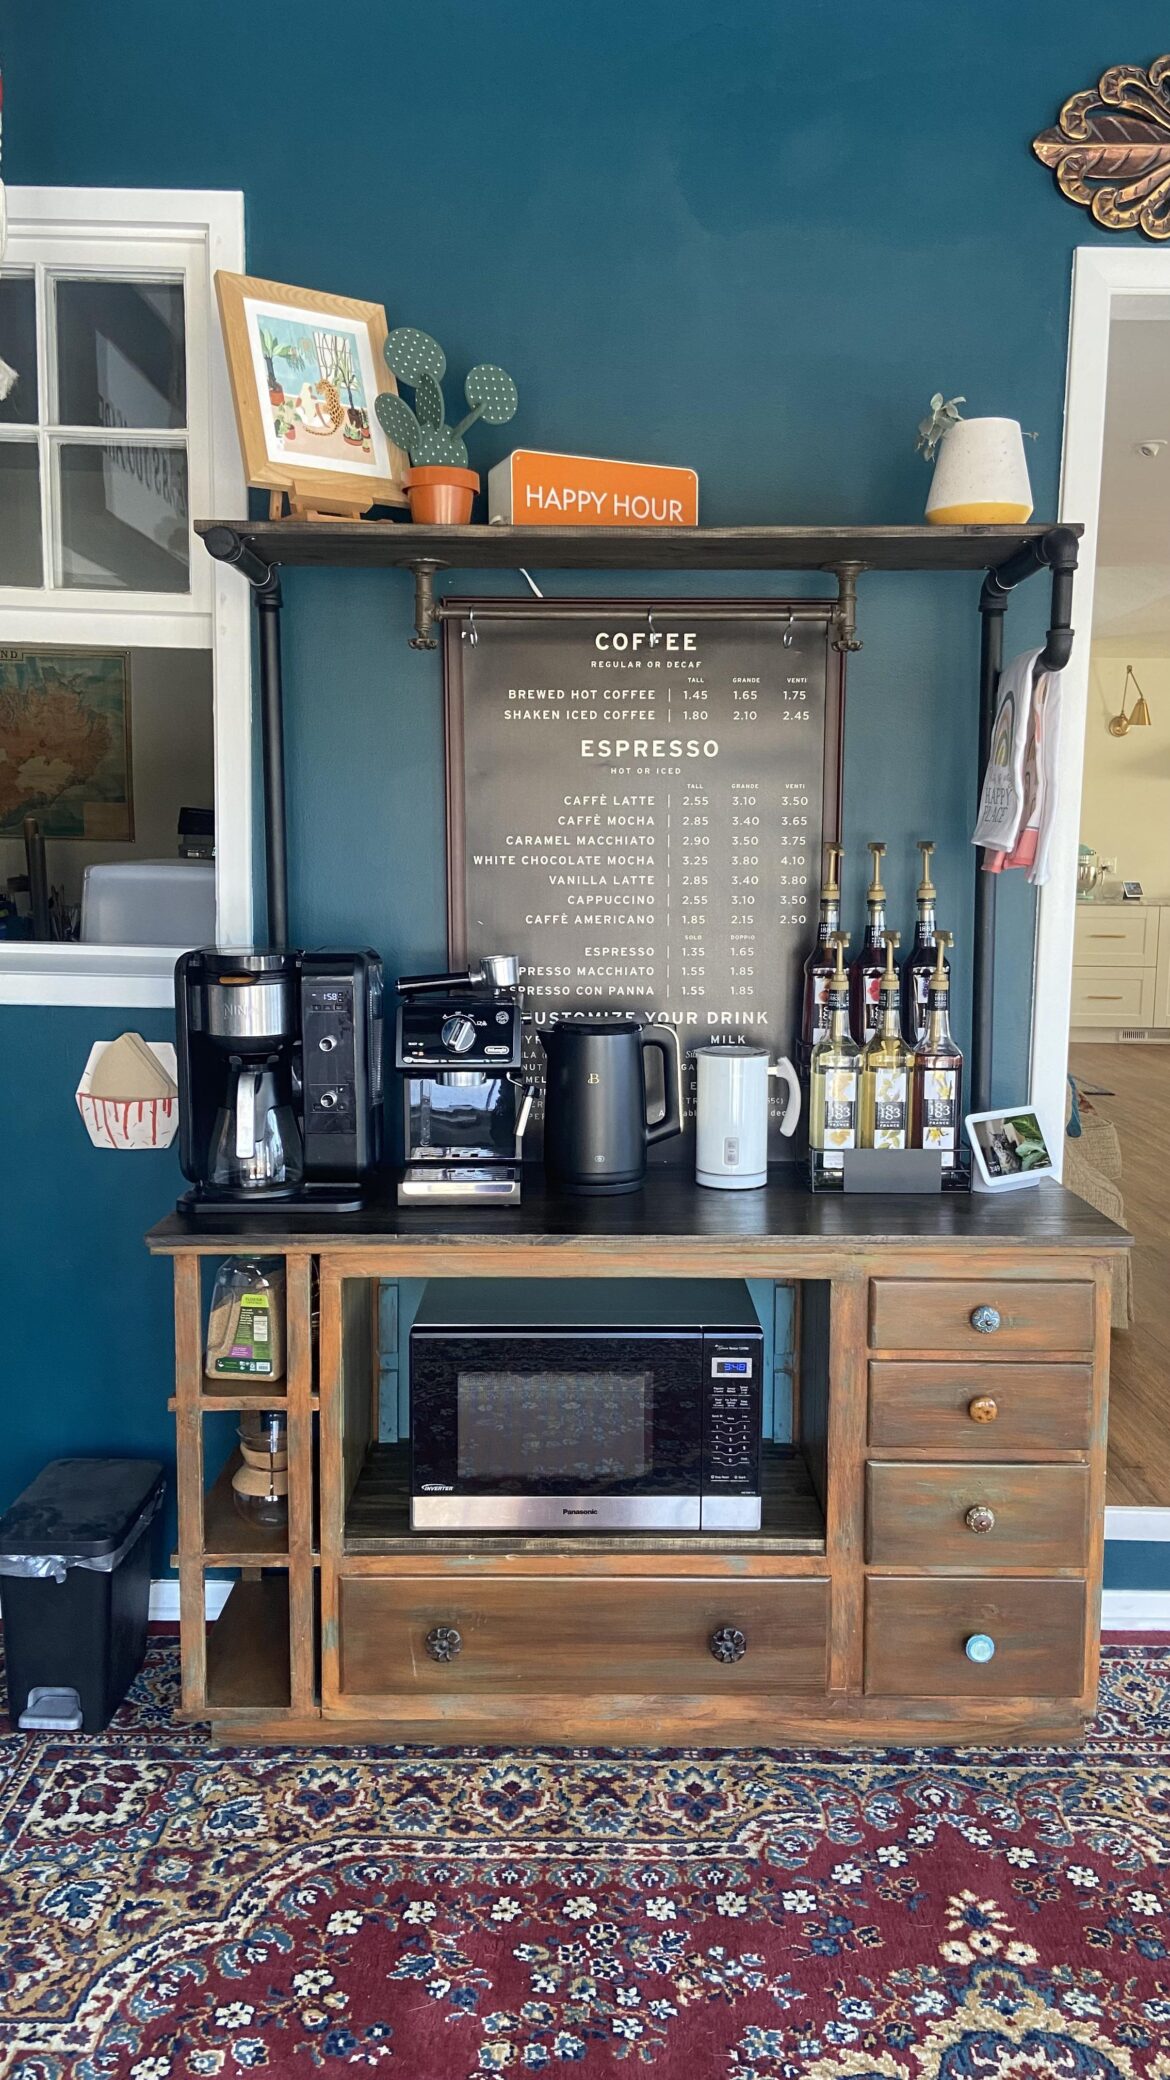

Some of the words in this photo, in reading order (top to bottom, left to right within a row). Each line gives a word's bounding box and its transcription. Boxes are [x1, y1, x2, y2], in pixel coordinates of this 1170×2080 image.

[526, 484, 608, 514] HAPPY
[613, 493, 684, 522] HOUR
[594, 631, 697, 652] COFFEE
[590, 660, 642, 669] REGULAR
[646, 660, 661, 669] OR
[666, 660, 702, 669] DECAF
[508, 689, 566, 700] BREWED
[570, 689, 598, 700] HOT
[603, 689, 656, 700] COFFEE
[683, 690, 708, 701] 1.45
[733, 690, 758, 701] 1.65
[783, 690, 807, 701] 1.75
[503, 709, 560, 720] SHAKEN
[566, 709, 598, 720] ICED
[603, 709, 656, 720] COFFEE
[683, 710, 709, 721] 1.80
[733, 710, 758, 721] 2.10
[782, 710, 810, 721] 2.45
[581, 740, 719, 758] ESPRESSO
[610, 767, 632, 775] HOT
[636, 767, 651, 775] OR
[656, 767, 681, 775] ICED
[563, 793, 608, 806] CAFFÈ
[613, 795, 655, 806] LATTE
[682, 796, 709, 806] 2.55
[732, 796, 757, 806] 3.10
[781, 796, 809, 806] 3.50
[984, 788, 1013, 806] HAPPY
[557, 813, 602, 826] CAFFÈ
[607, 815, 655, 826] MOCHA
[682, 816, 709, 826] 2.85
[732, 816, 760, 826] 3.40
[781, 816, 808, 826] 3.65
[983, 805, 1009, 823] PLACE
[505, 835, 572, 846] CARAMEL
[576, 835, 655, 846] MACCHIATO
[682, 835, 710, 846] 2.90
[732, 835, 759, 846] 3.50
[781, 835, 806, 846] 3.75
[473, 855, 516, 866] WHITE
[521, 855, 602, 866] CHOCOLATE
[607, 855, 655, 866] MOCHA
[682, 855, 708, 866] 3.25
[732, 855, 759, 866] 3.80
[780, 855, 806, 866] 4.10
[548, 875, 608, 886] VANILLA
[613, 875, 655, 886] LATTE
[682, 875, 708, 886] 2.85
[731, 875, 759, 886] 3.40
[780, 875, 808, 886] 3.80
[567, 894, 655, 905] CAPPUCCINO
[682, 895, 708, 905] 2.55
[731, 895, 756, 905] 3.10
[779, 895, 807, 905] 3.50
[525, 912, 569, 925] CAFFÈ
[573, 914, 655, 925] AMERICANO
[681, 914, 706, 925] 1.85
[731, 914, 754, 925] 2.15
[779, 914, 807, 925] 2.50
[584, 946, 655, 957] ESPRESSO
[682, 947, 705, 957] 1.35
[730, 947, 755, 957] 1.65
[519, 966, 571, 976] PRESSO
[576, 966, 655, 976] MACCHIATO
[682, 966, 705, 976] 1.55
[730, 966, 754, 976] 1.85
[502, 985, 571, 996] SPRESSO
[575, 985, 603, 996] CON
[608, 985, 655, 996] PANNA
[682, 985, 705, 996] 1.55
[730, 985, 754, 996] 1.85
[644, 1011, 698, 1025] YOUR
[707, 1011, 769, 1025] DRINK
[710, 1035, 746, 1044] MILK
